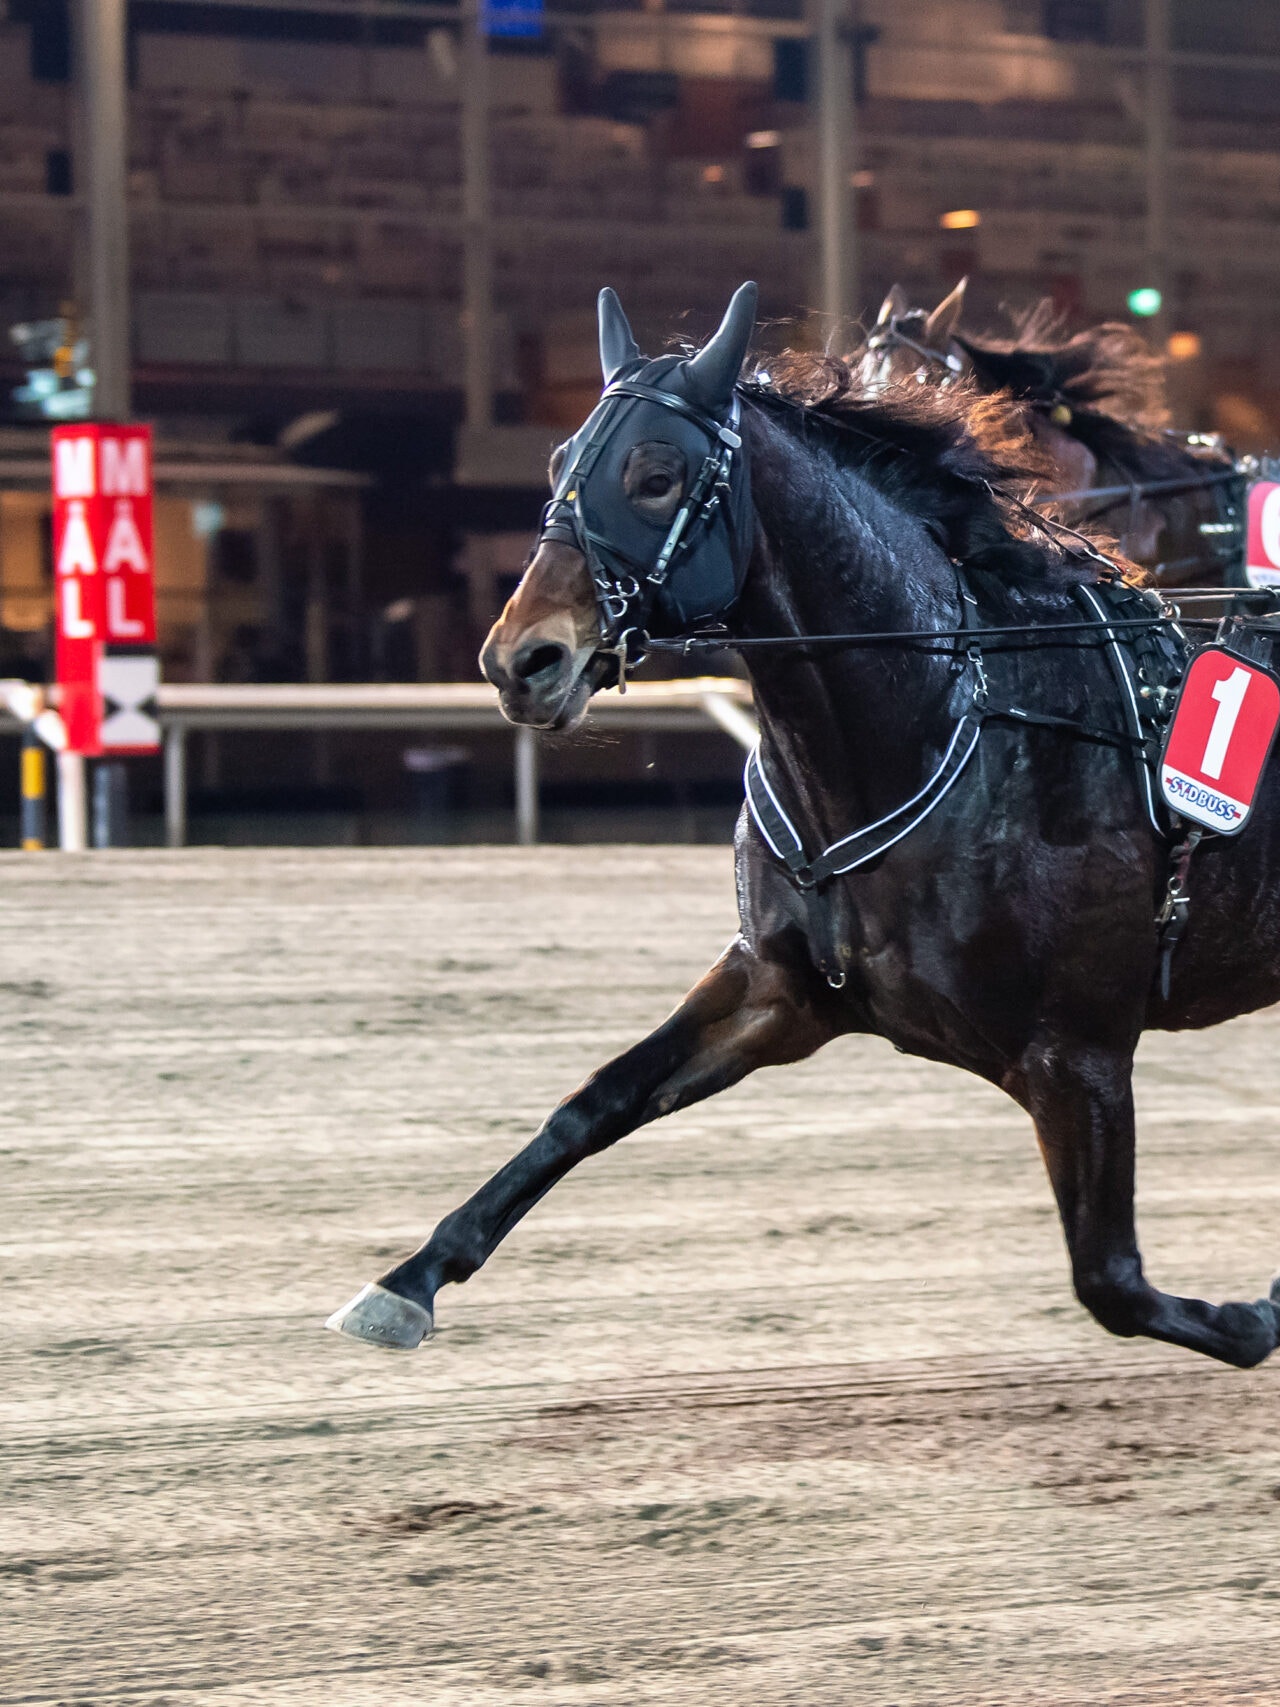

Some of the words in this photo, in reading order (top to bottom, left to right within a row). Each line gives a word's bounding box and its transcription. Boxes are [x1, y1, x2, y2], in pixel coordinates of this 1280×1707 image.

[56, 437, 96, 639] MÅL
[102, 437, 148, 638] MÅL
[1169, 777, 1236, 820] SYDBUSS
[1200, 667, 1252, 780] 1
